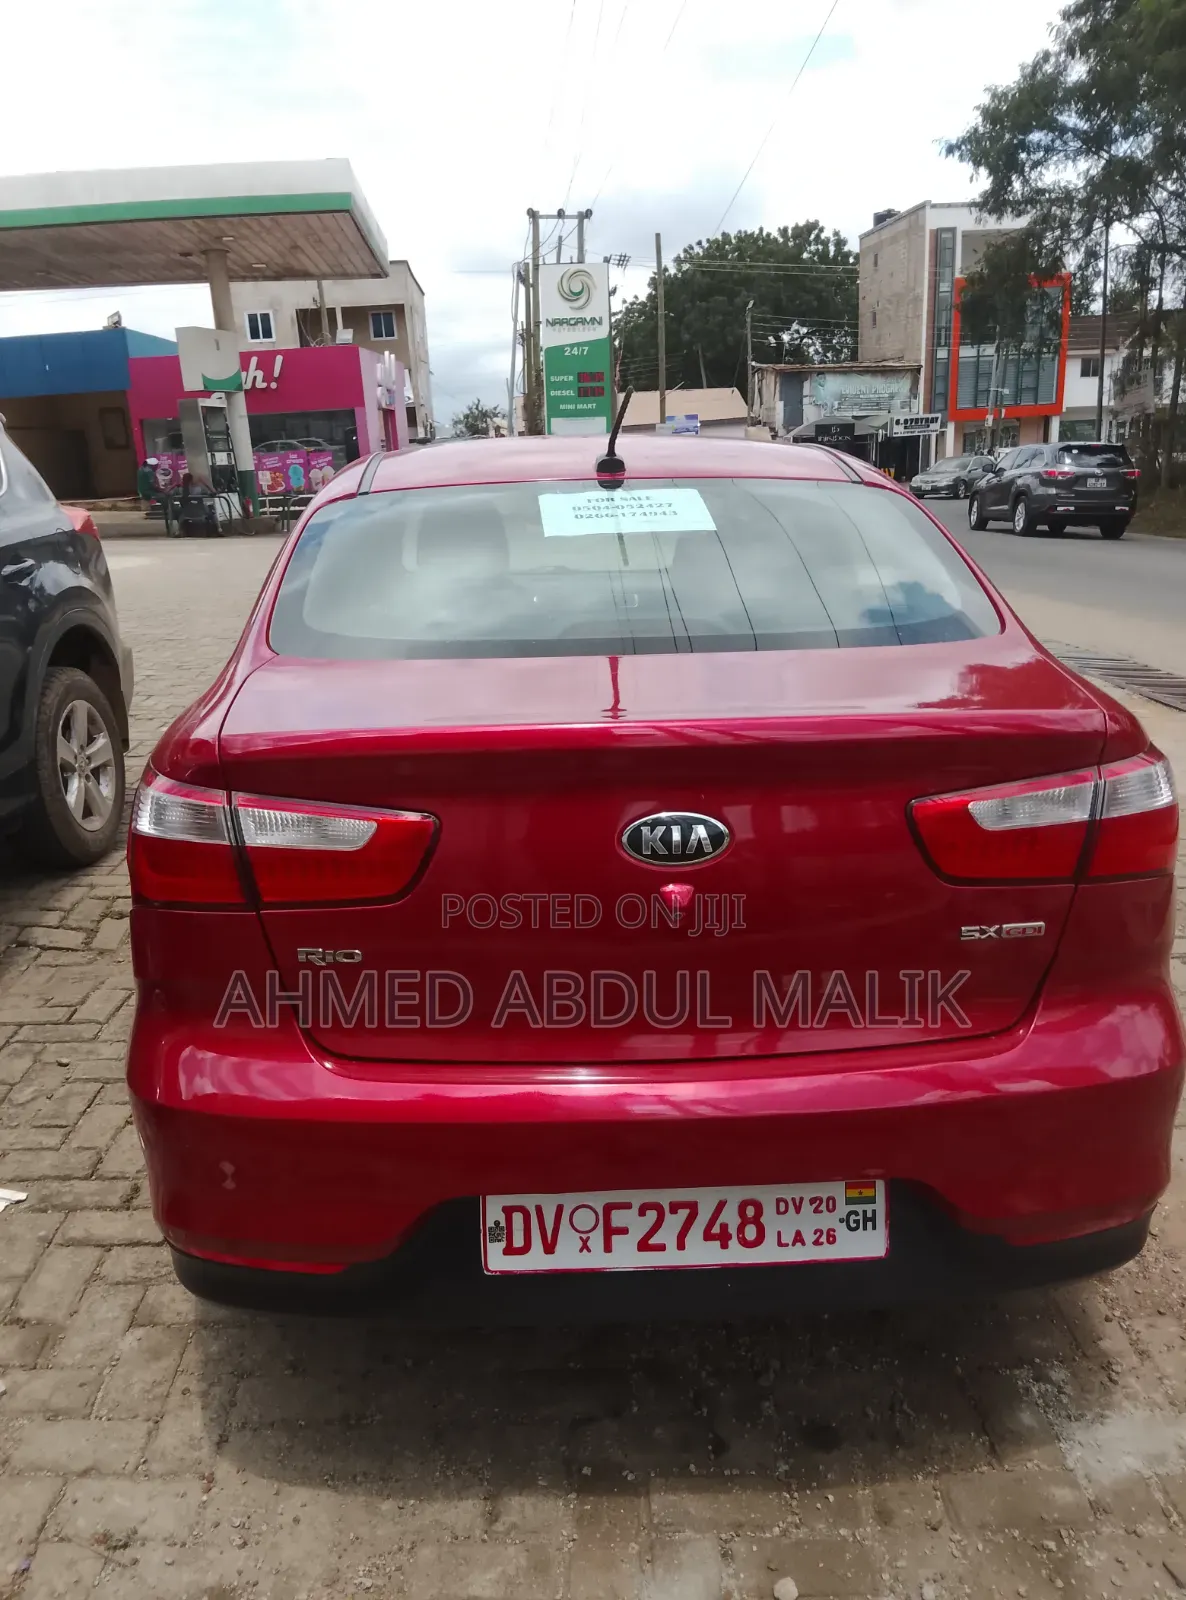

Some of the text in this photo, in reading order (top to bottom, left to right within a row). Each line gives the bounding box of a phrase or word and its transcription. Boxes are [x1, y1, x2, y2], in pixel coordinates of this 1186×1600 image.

[564, 346, 589, 356] 24/7
[550, 389, 575, 397] DIESEL
[640, 824, 713, 855] KIA
[960, 924, 1000, 941] SX
[775, 1195, 837, 1216] DV 20
[501, 1198, 766, 1256] DV F2748
[845, 1209, 877, 1232] GH
[776, 1228, 837, 1248] LA 26
